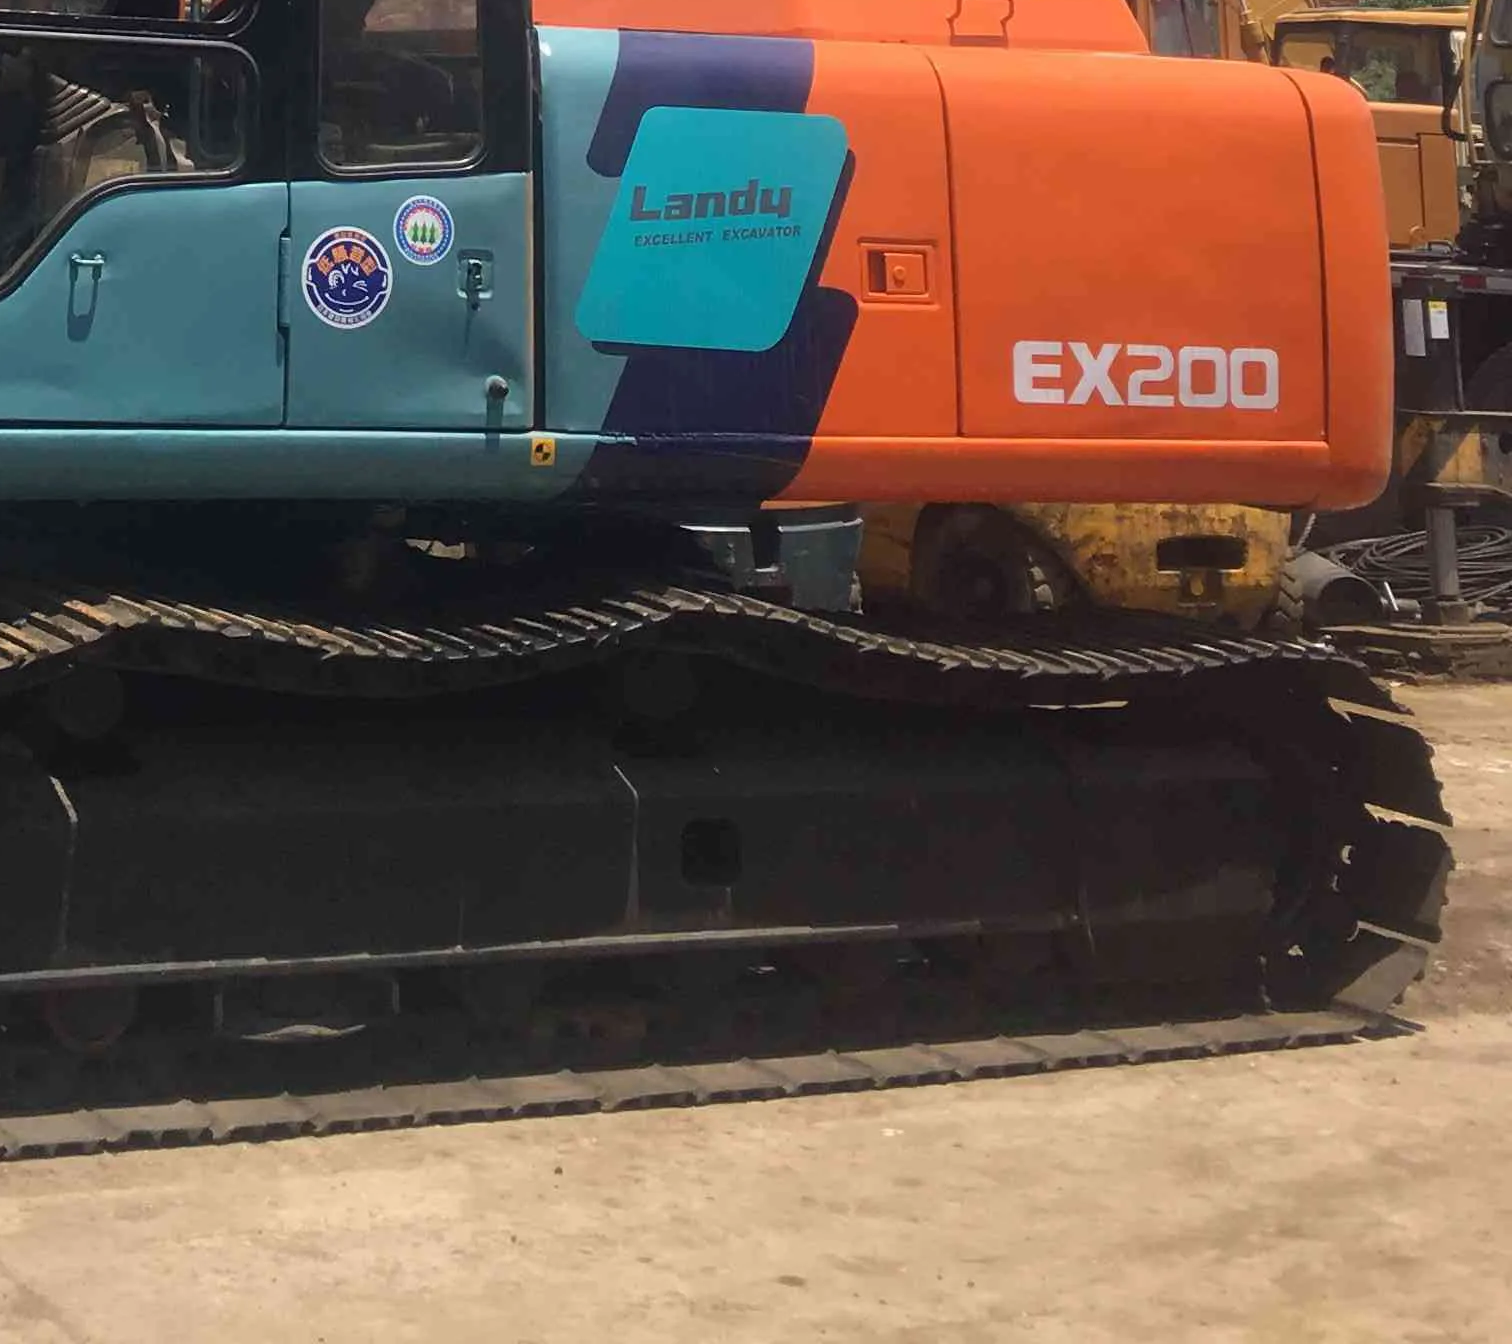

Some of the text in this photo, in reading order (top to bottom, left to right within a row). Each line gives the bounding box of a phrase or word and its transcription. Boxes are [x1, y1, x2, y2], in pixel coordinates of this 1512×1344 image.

[629, 178, 792, 221] Landy
[634, 225, 801, 247] EXCELLENT EXCAVATOR
[1013, 340, 1279, 409] EX200
